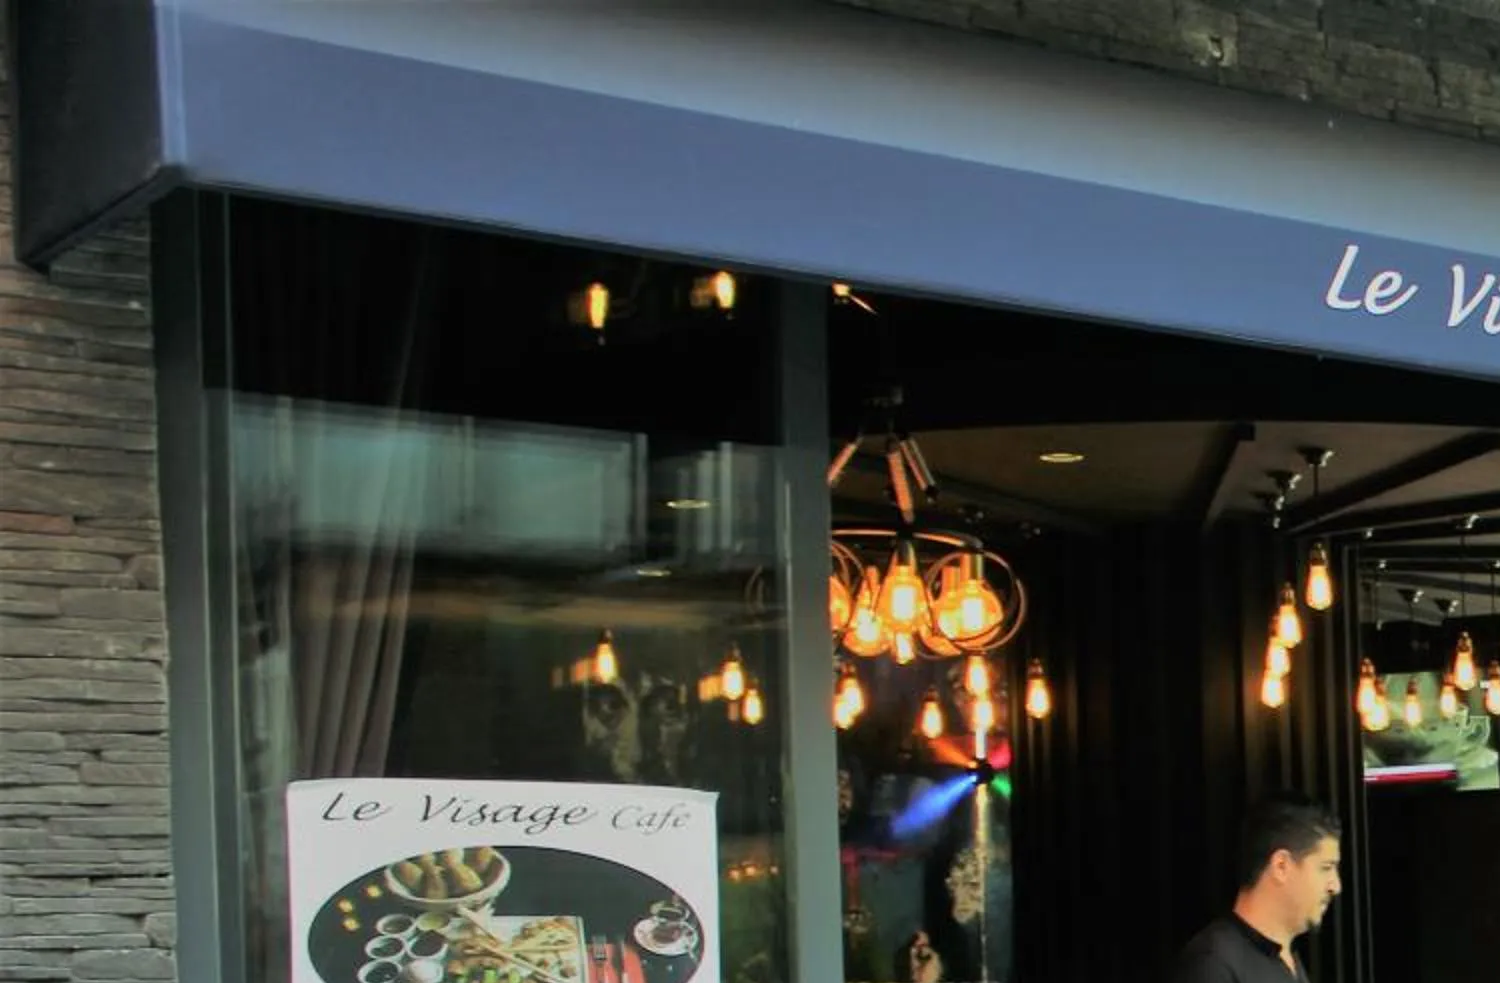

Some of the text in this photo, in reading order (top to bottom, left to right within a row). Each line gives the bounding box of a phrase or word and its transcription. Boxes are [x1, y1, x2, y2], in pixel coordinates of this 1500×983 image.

[1325, 244, 1418, 315] Le
[322, 791, 394, 822] Le
[418, 793, 597, 834] Visage
